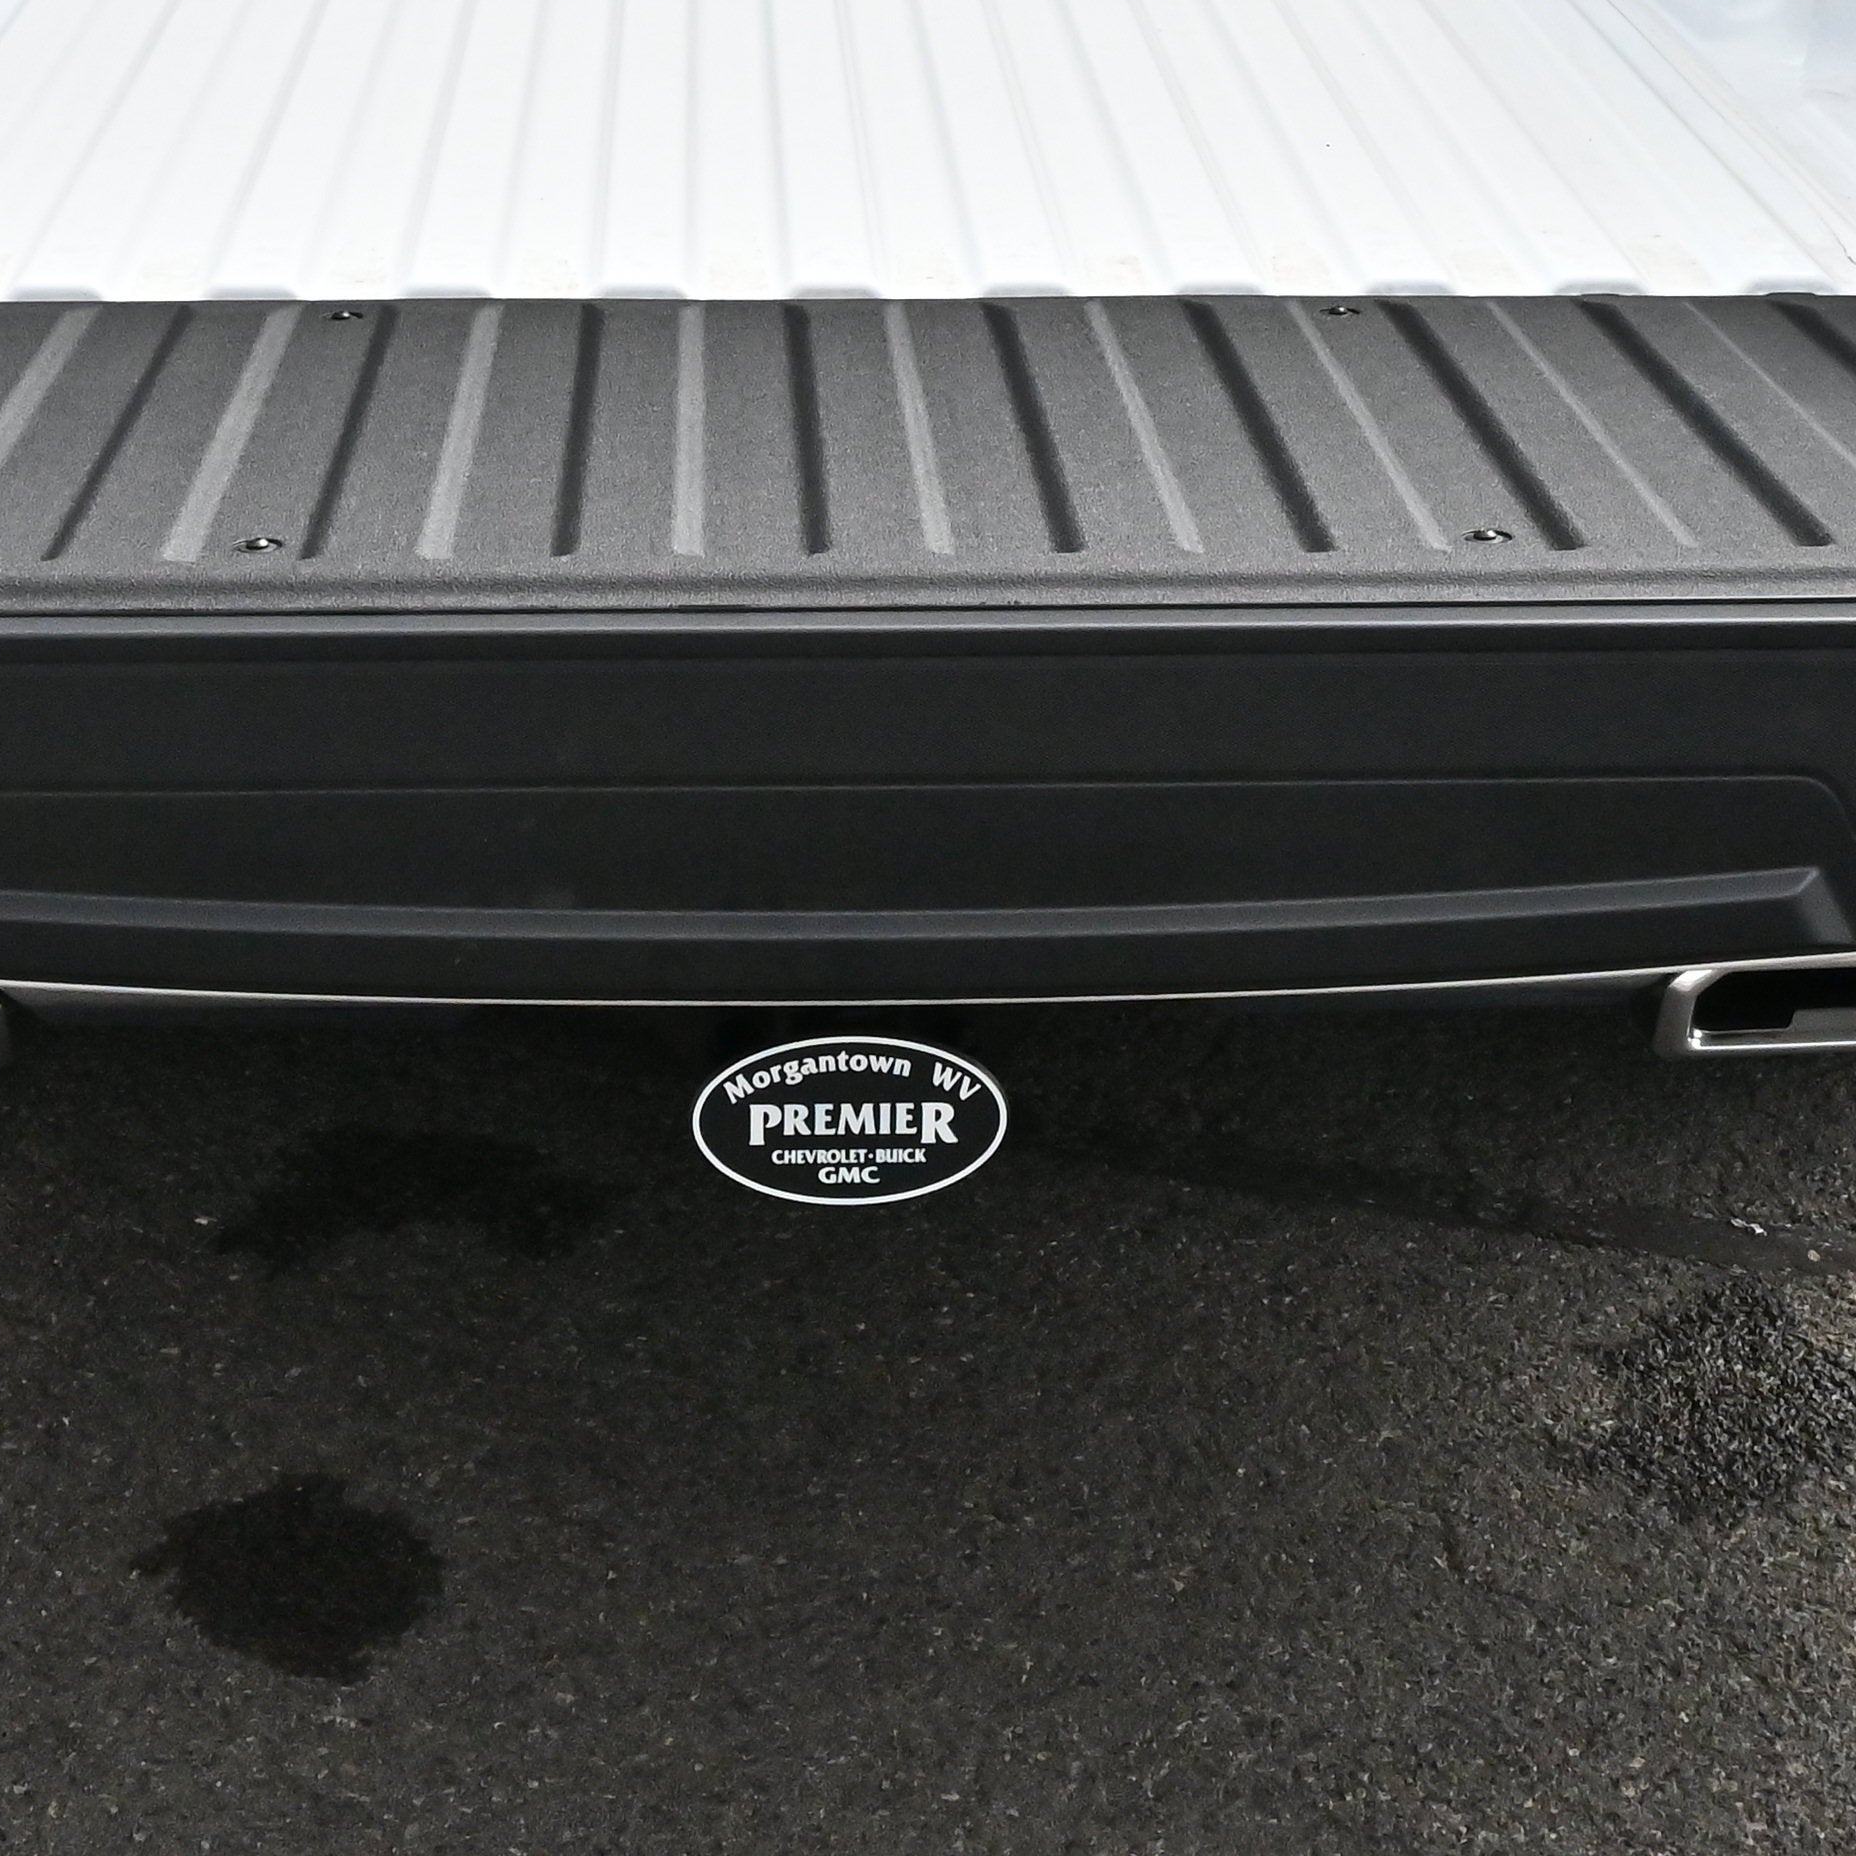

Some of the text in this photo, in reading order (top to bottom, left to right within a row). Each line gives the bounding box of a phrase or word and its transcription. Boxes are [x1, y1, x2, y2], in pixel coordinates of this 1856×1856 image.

[722, 1050, 982, 1105] Morgantown WV
[748, 1101, 959, 1146] PREMIER
[817, 1166, 881, 1184] GMC
